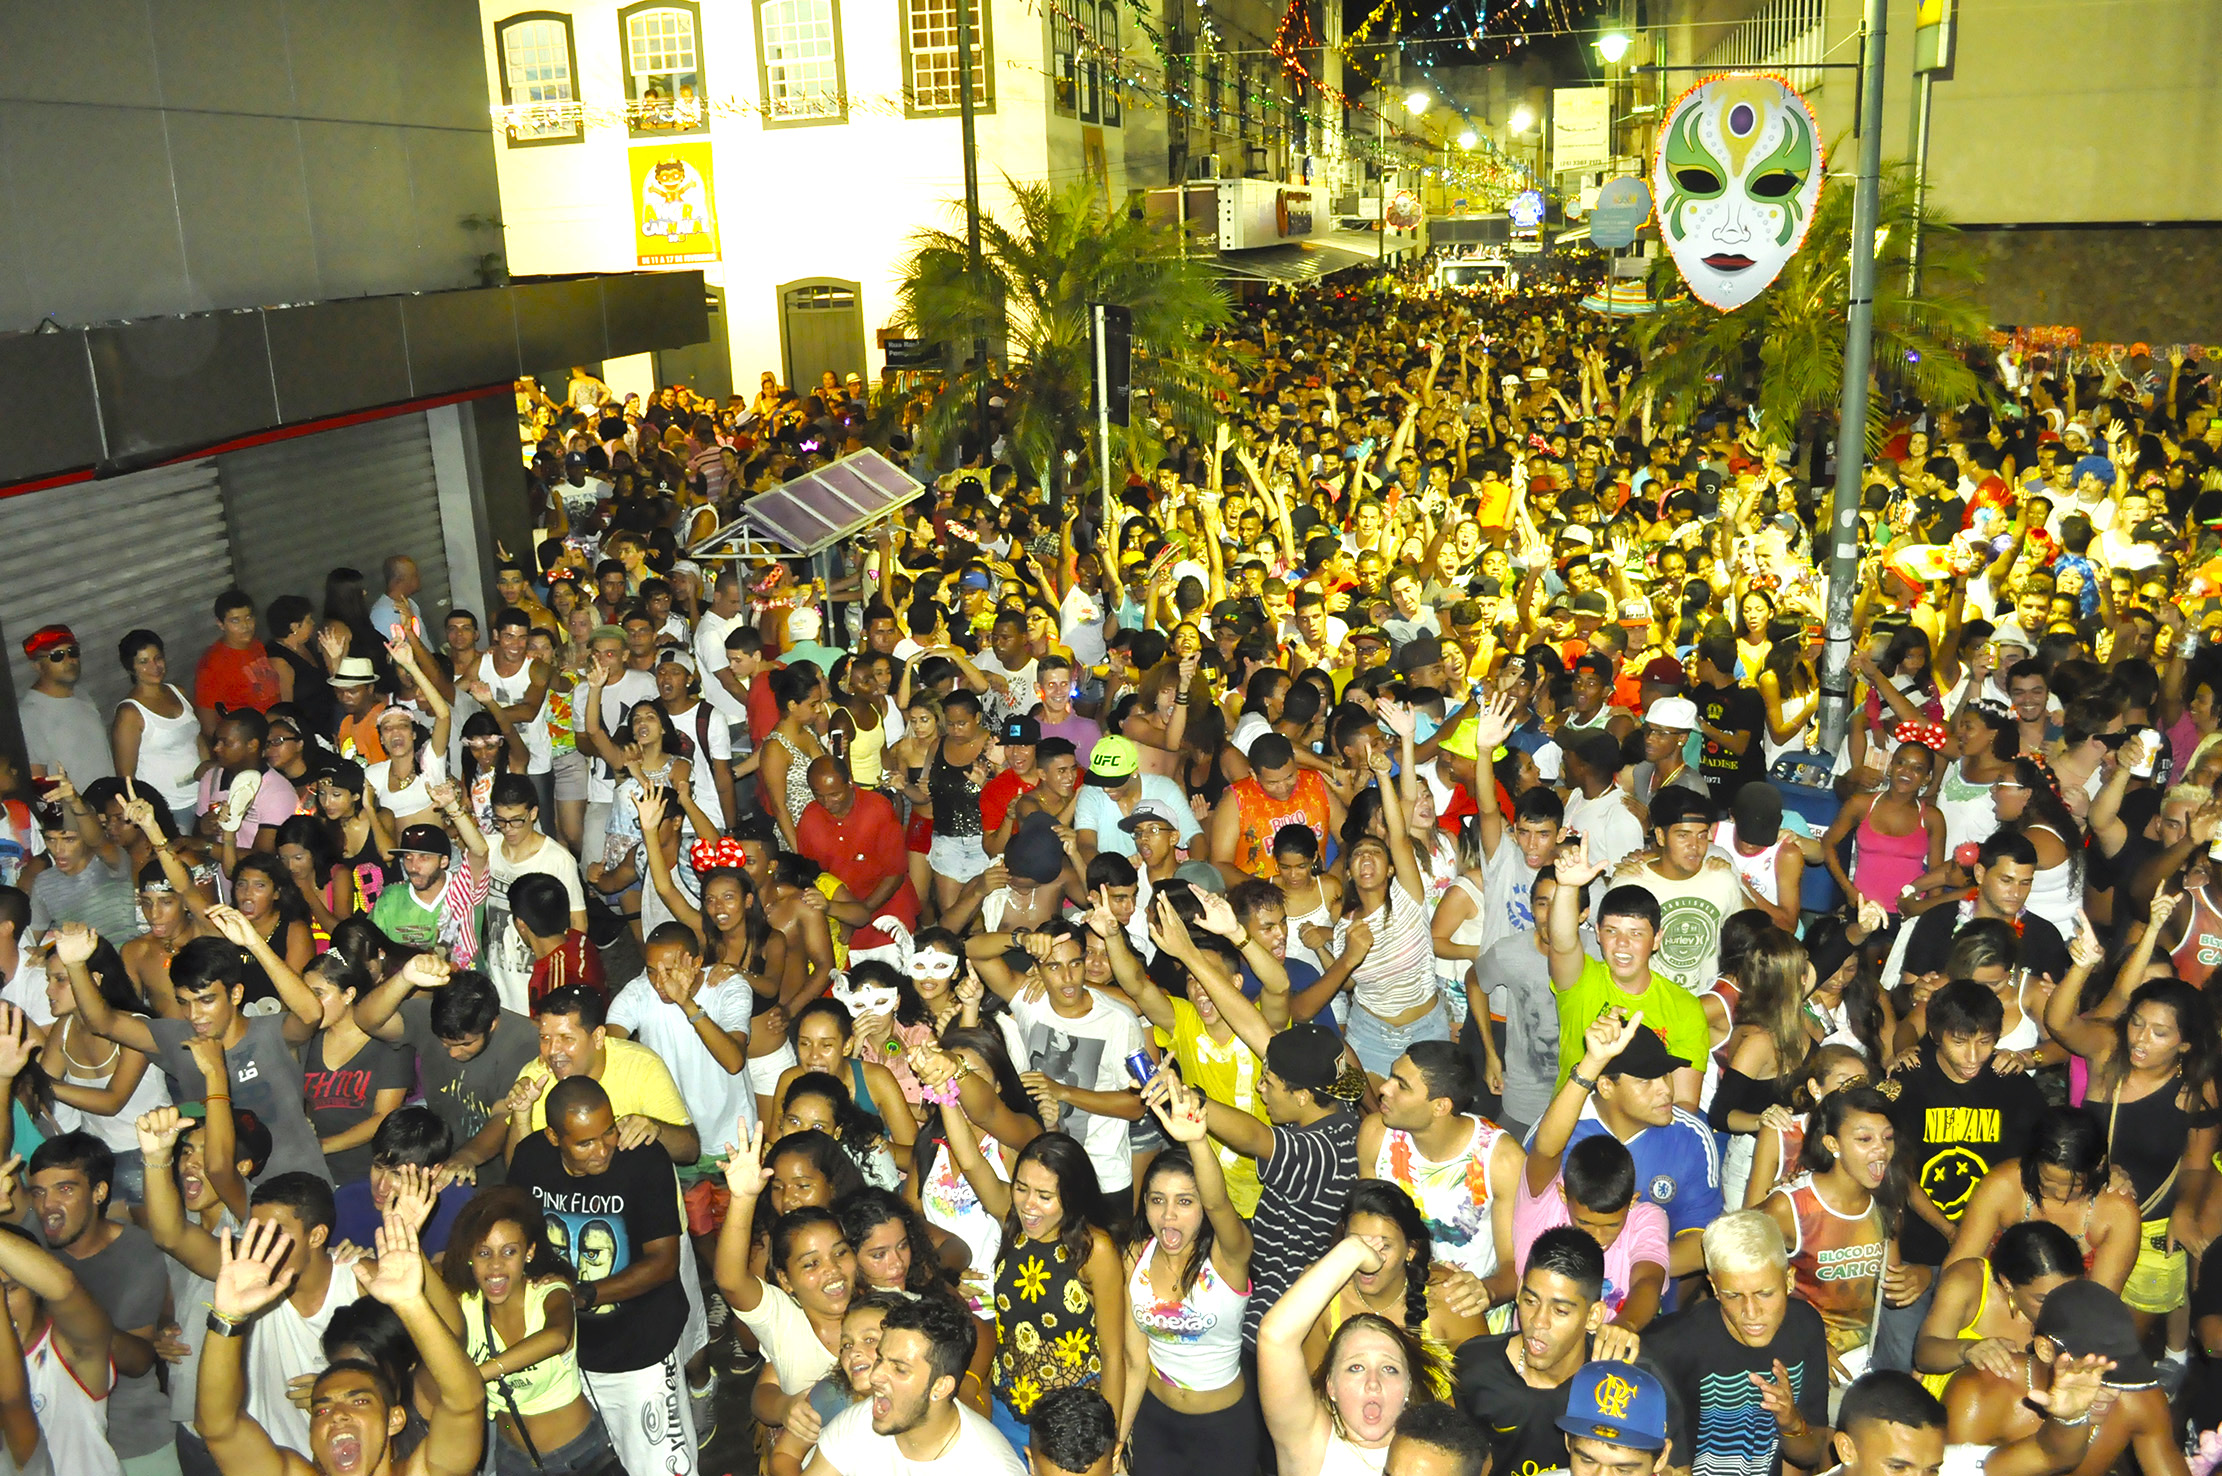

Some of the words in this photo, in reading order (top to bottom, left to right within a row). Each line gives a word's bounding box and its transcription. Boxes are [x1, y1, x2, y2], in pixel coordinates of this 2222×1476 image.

[1093, 754, 1121, 767] UFC
[1661, 900, 1716, 916] TABLISHED
[1664, 933, 1695, 946] Hurley
[1923, 1106, 2001, 1143] NIRVANA
[533, 1186, 568, 1212] PINK
[571, 1193, 624, 1214] FLOYD
[1817, 1246, 1864, 1264] BLOCO
[1864, 1242, 1884, 1258] DA
[1815, 1259, 1882, 1280] CARIO
